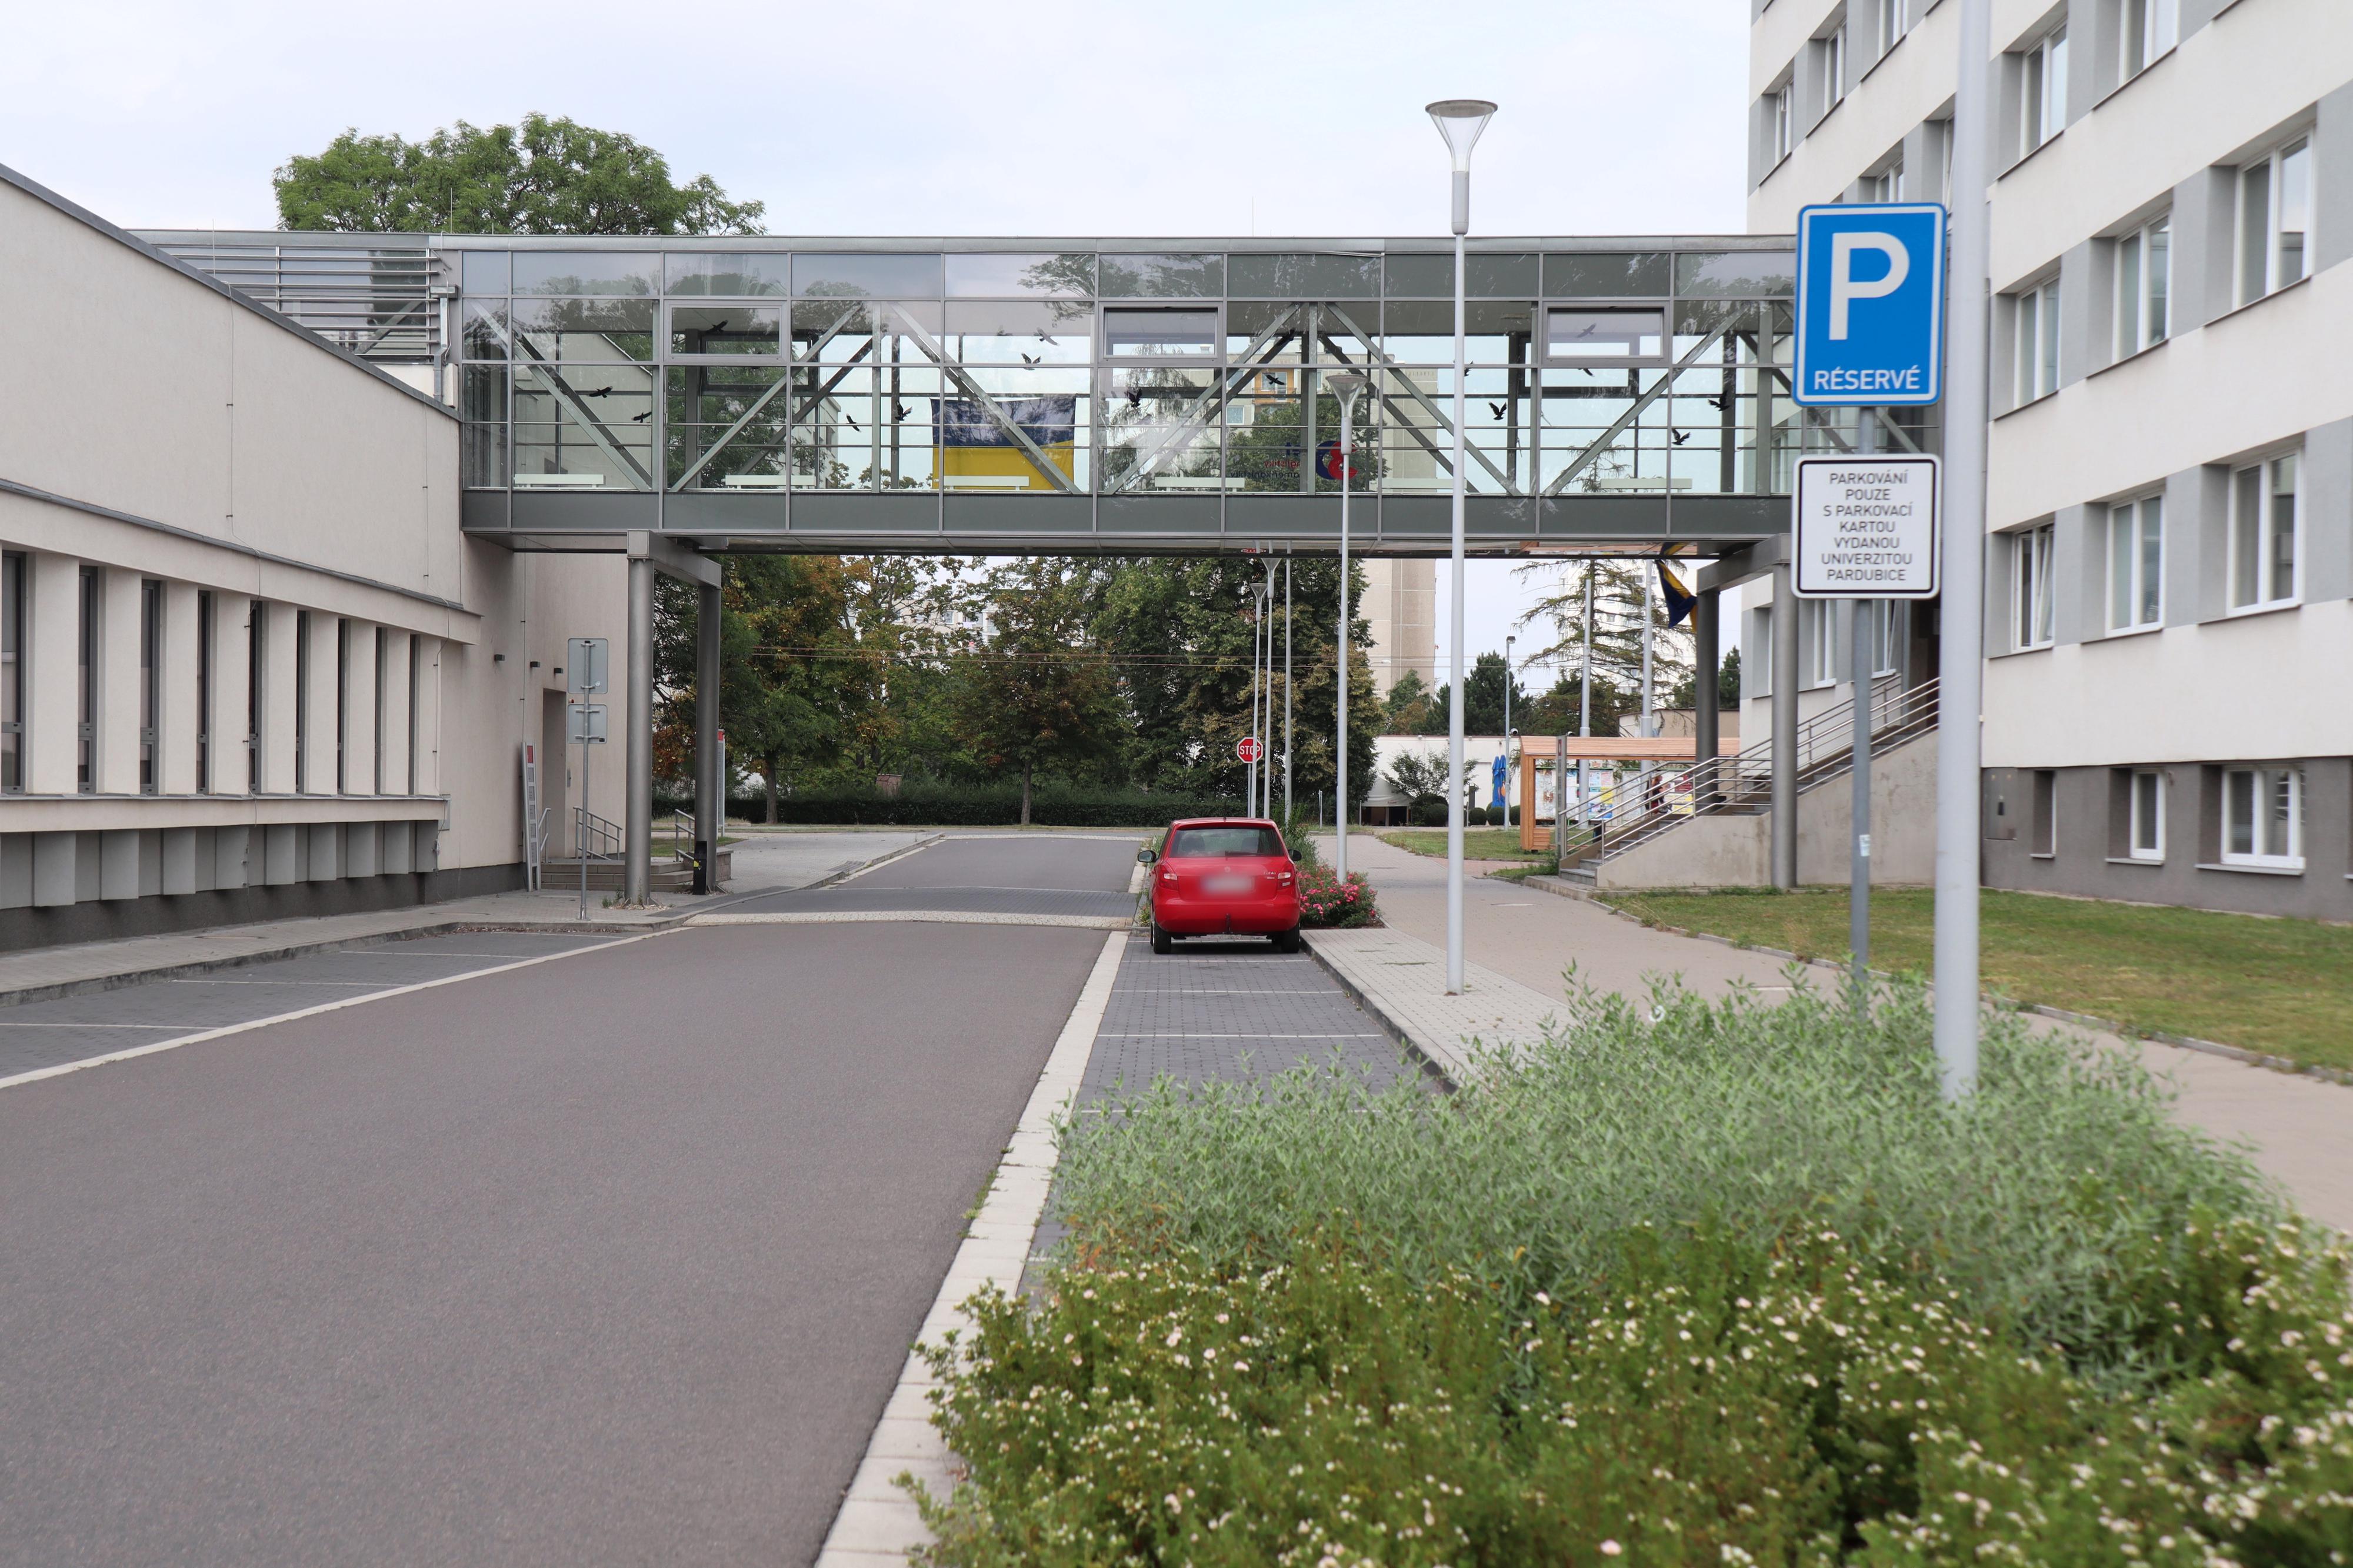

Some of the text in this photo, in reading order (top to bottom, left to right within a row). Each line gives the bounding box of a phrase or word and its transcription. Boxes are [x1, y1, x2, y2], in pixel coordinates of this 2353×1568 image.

[1828, 232, 1910, 341] P
[1814, 365, 1921, 390] RÉSERVÉ
[1829, 469, 1909, 485] PARKOVÁNÍ
[1845, 489, 1891, 501] POUZE
[1823, 502, 1913, 516] S PARKOVACÍ
[1839, 521, 1895, 532] KARTOU
[1834, 537, 1900, 548] VYDANOU
[1821, 553, 1912, 565] UNIVERZITOU
[1827, 569, 1907, 581] PARDUBICE
[1239, 745, 1261, 755] STOP
